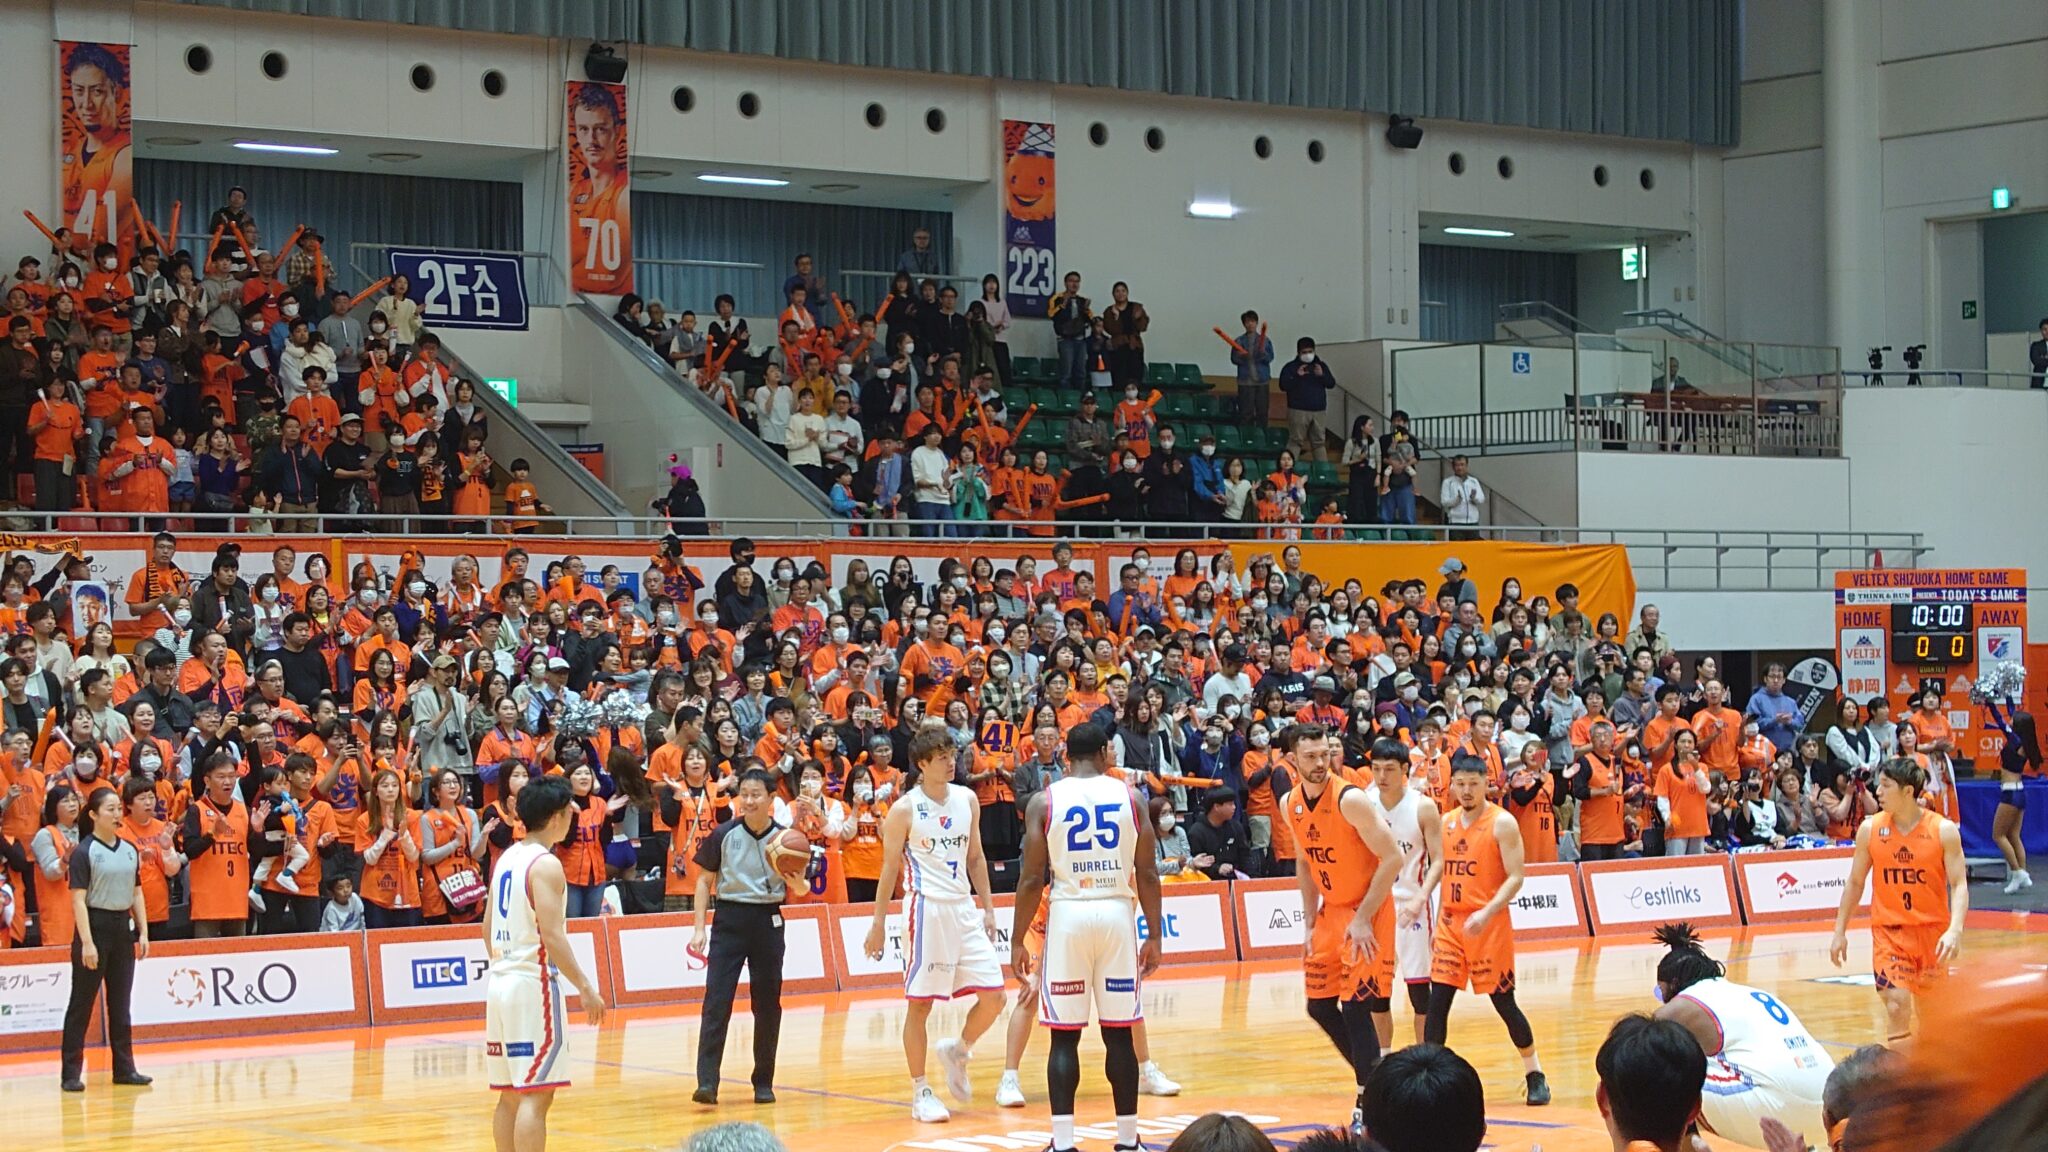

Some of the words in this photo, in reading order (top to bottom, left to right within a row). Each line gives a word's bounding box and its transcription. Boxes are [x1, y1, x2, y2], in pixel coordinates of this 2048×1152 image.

[73, 189, 117, 245] 41
[579, 218, 621, 271] 70
[1008, 247, 1054, 296] 223
[1853, 573, 1889, 587] VELTEX
[1893, 573, 1941, 586] SHIZUOKA
[1946, 572, 1975, 585] HOME
[1979, 572, 2009, 585] GAME
[1892, 592, 1910, 600] RUN
[1941, 589, 1986, 601] TODAY'S
[1990, 589, 2019, 601] GAME
[1843, 612, 1882, 626] HOME
[1912, 605, 1963, 627] 10:00
[1981, 610, 2019, 625] AWAY
[1845, 648, 1882, 659] VELTEX
[1916, 636, 1930, 657] 0
[1951, 635, 1964, 657] 0
[1847, 678, 1880, 694] 静岡
[1801, 687, 1821, 716] RUN
[984, 724, 1014, 753] 41
[1063, 803, 1123, 851] 25
[211, 841, 243, 855] ITEC
[227, 860, 234, 877] 3
[946, 861, 958, 879] 7
[1072, 859, 1122, 873] BURRELL
[1444, 860, 1477, 876] ITEC
[1883, 867, 1927, 884] ITEC
[499, 869, 513, 919] 0
[1451, 883, 1462, 903] 16
[1902, 892, 1911, 910] 3
[415, 961, 464, 985] ITEC
[210, 962, 297, 1008] R&O
[1749, 992, 1790, 1026] 8
